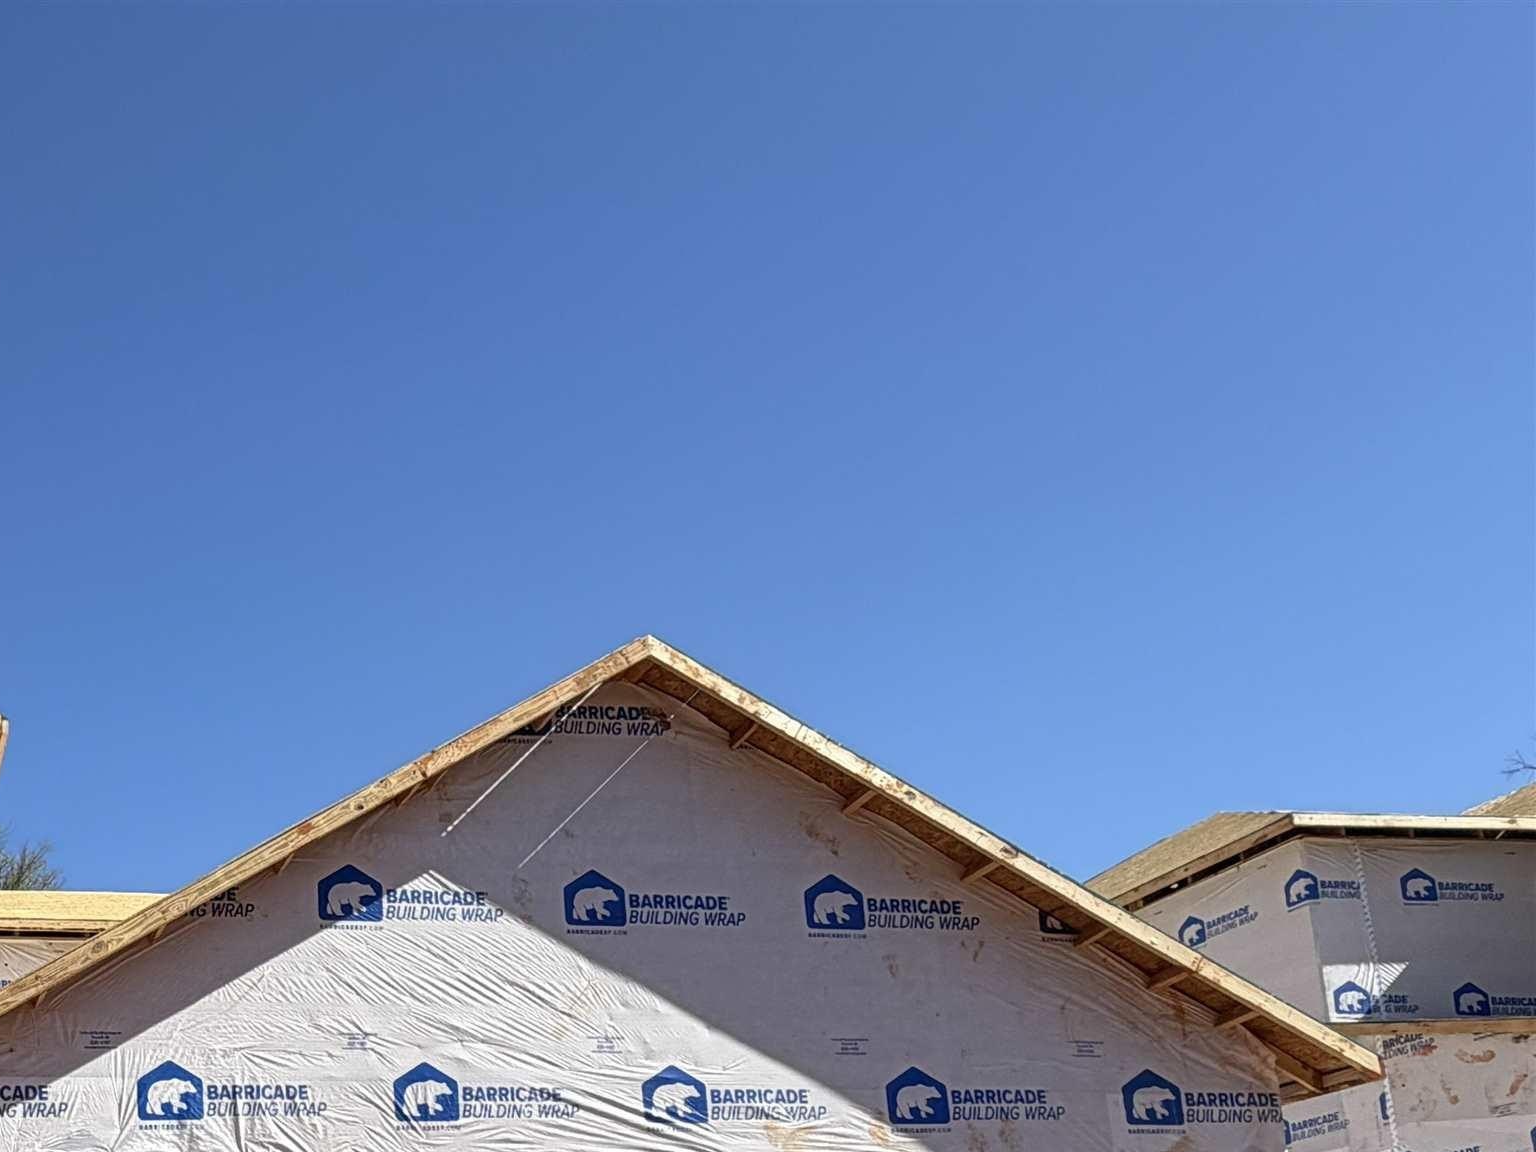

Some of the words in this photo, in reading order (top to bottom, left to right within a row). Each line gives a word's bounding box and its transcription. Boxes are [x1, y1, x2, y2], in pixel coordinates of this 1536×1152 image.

[554, 720, 622, 735] BUILDING
[1438, 882, 1495, 892] BARRICADE
[386, 890, 486, 905] BARRICADE
[629, 894, 727, 910] BARRICADE
[1440, 892, 1478, 900] BUILDING
[1480, 893, 1504, 901] WRAP
[212, 904, 254, 917] WRAP
[386, 906, 458, 921] BUILDING
[462, 908, 504, 922] WRAP
[867, 898, 962, 914] BARRICADE
[629, 910, 700, 926] BUILDING
[704, 912, 746, 927] WRAP
[868, 914, 938, 929] BUILDING
[941, 916, 980, 930] WRAP
[1206, 906, 1250, 930] BARRICADE
[1206, 920, 1238, 940] BUILDING
[1239, 912, 1258, 927] WRAP
[207, 1086, 308, 1100] BARRICADE
[464, 1087, 561, 1102] BARRICADE
[711, 1089, 808, 1105] BARRICADE
[952, 1089, 1046, 1105] BARRICADE
[1185, 1093, 1279, 1108] BARRICADE
[22, 1103, 68, 1118] WRAP
[207, 1102, 279, 1117] BUILDING
[284, 1102, 327, 1117] WRAP
[464, 1102, 533, 1118] BUILDING
[538, 1104, 580, 1118] WRAP
[711, 1105, 780, 1120] BUILDING
[786, 1106, 828, 1121] WRAP
[952, 1105, 1019, 1120] BUILDING
[1024, 1106, 1066, 1120] WRAP
[1186, 1108, 1252, 1124] BUILDING
[1292, 1112, 1340, 1131] BARRICADE
[1292, 1124, 1326, 1142] BUILDING
[1328, 1120, 1350, 1134] WRAP
